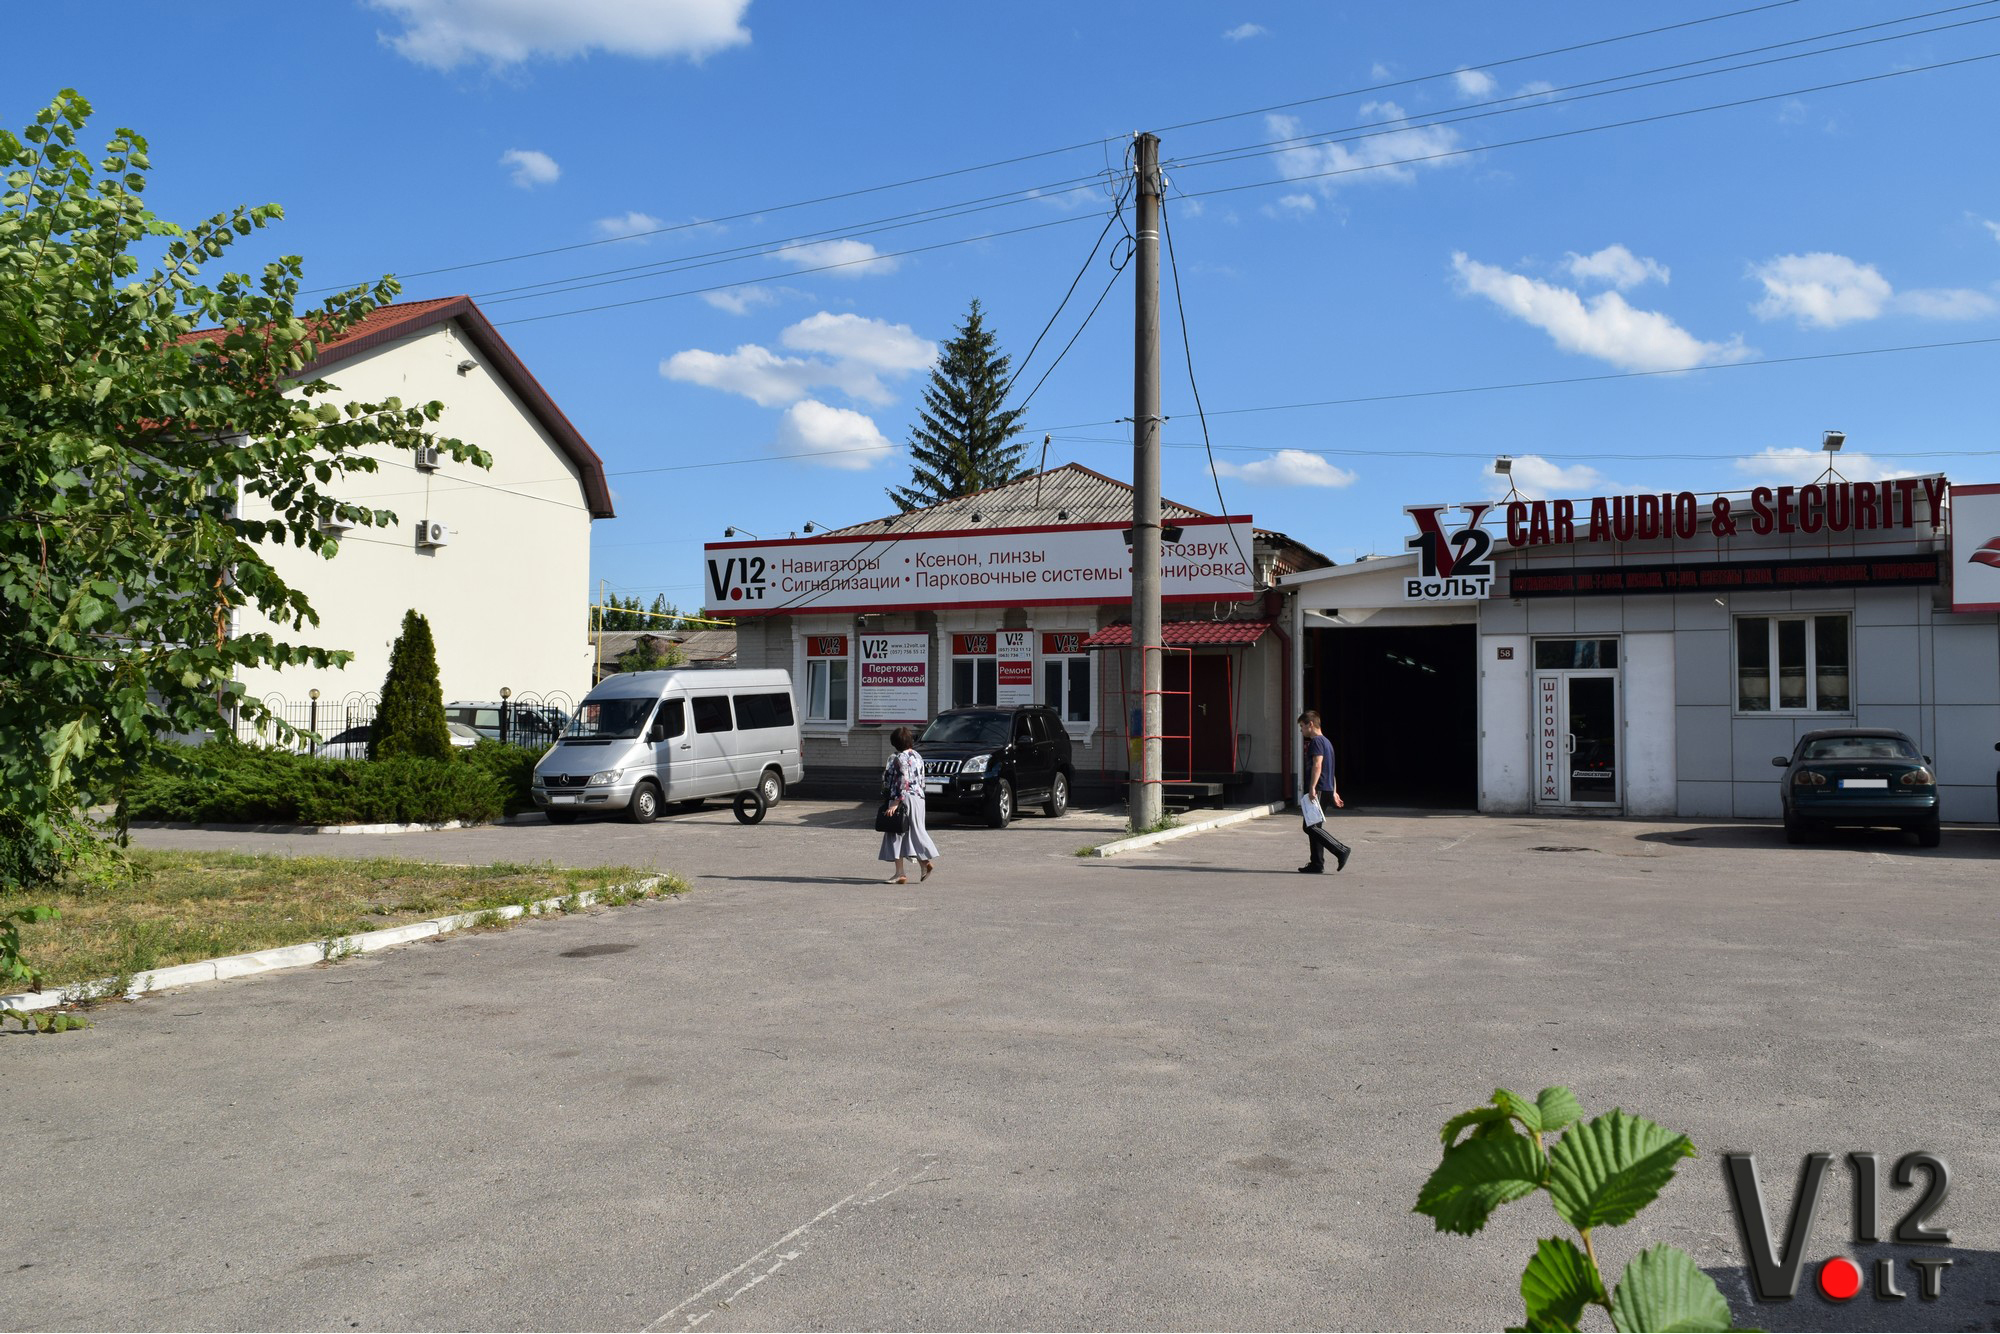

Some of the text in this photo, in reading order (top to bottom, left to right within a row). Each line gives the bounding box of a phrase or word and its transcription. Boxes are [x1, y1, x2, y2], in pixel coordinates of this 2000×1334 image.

[1506, 476, 1947, 547] CAR AUDIO & SECURITY
[781, 557, 880, 575] Навигаторы
[915, 551, 982, 568] Ксенон,
[988, 550, 1045, 565] линзы
[781, 575, 900, 593] Сигнализации
[915, 570, 1037, 590] Парковочные
[1041, 566, 1122, 583] системы
[1500, 649, 1511, 658] 58
[869, 664, 919, 674] Перетяжка
[999, 666, 1031, 675] Ремонт
[896, 674, 926, 683] кожей
[1543, 682, 1556, 795] ШИНОМОНТАЖ
